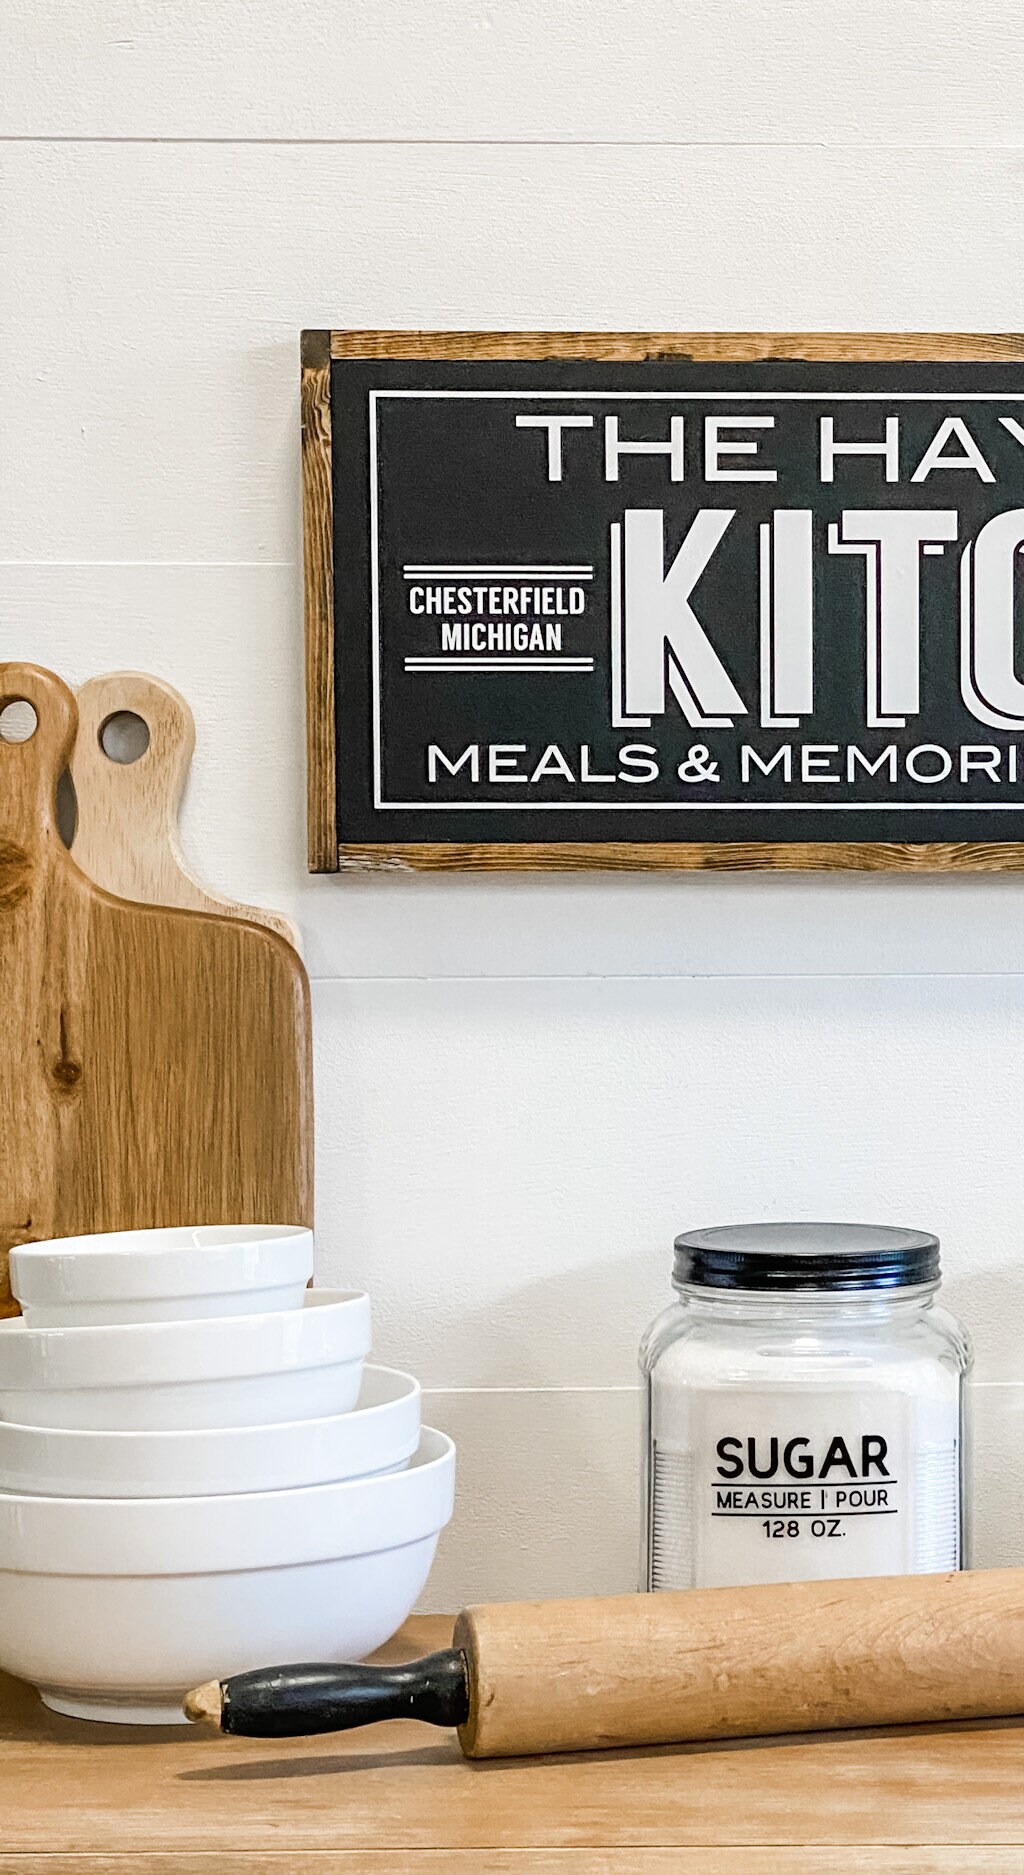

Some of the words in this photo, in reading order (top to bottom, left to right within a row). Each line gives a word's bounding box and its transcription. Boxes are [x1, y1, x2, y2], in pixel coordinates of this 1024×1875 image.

[516, 416, 777, 481] THE
[410, 587, 584, 614] CHESTERFIELD
[442, 623, 561, 650] MICHIGAN
[429, 744, 659, 782] MEALS
[678, 745, 719, 782] &
[716, 1435, 891, 1479] SUGAR
[716, 1491, 812, 1509] MEASURE
[836, 1489, 889, 1508] POUR
[762, 1519, 800, 1538] 128
[811, 1519, 846, 1538] OZ.
